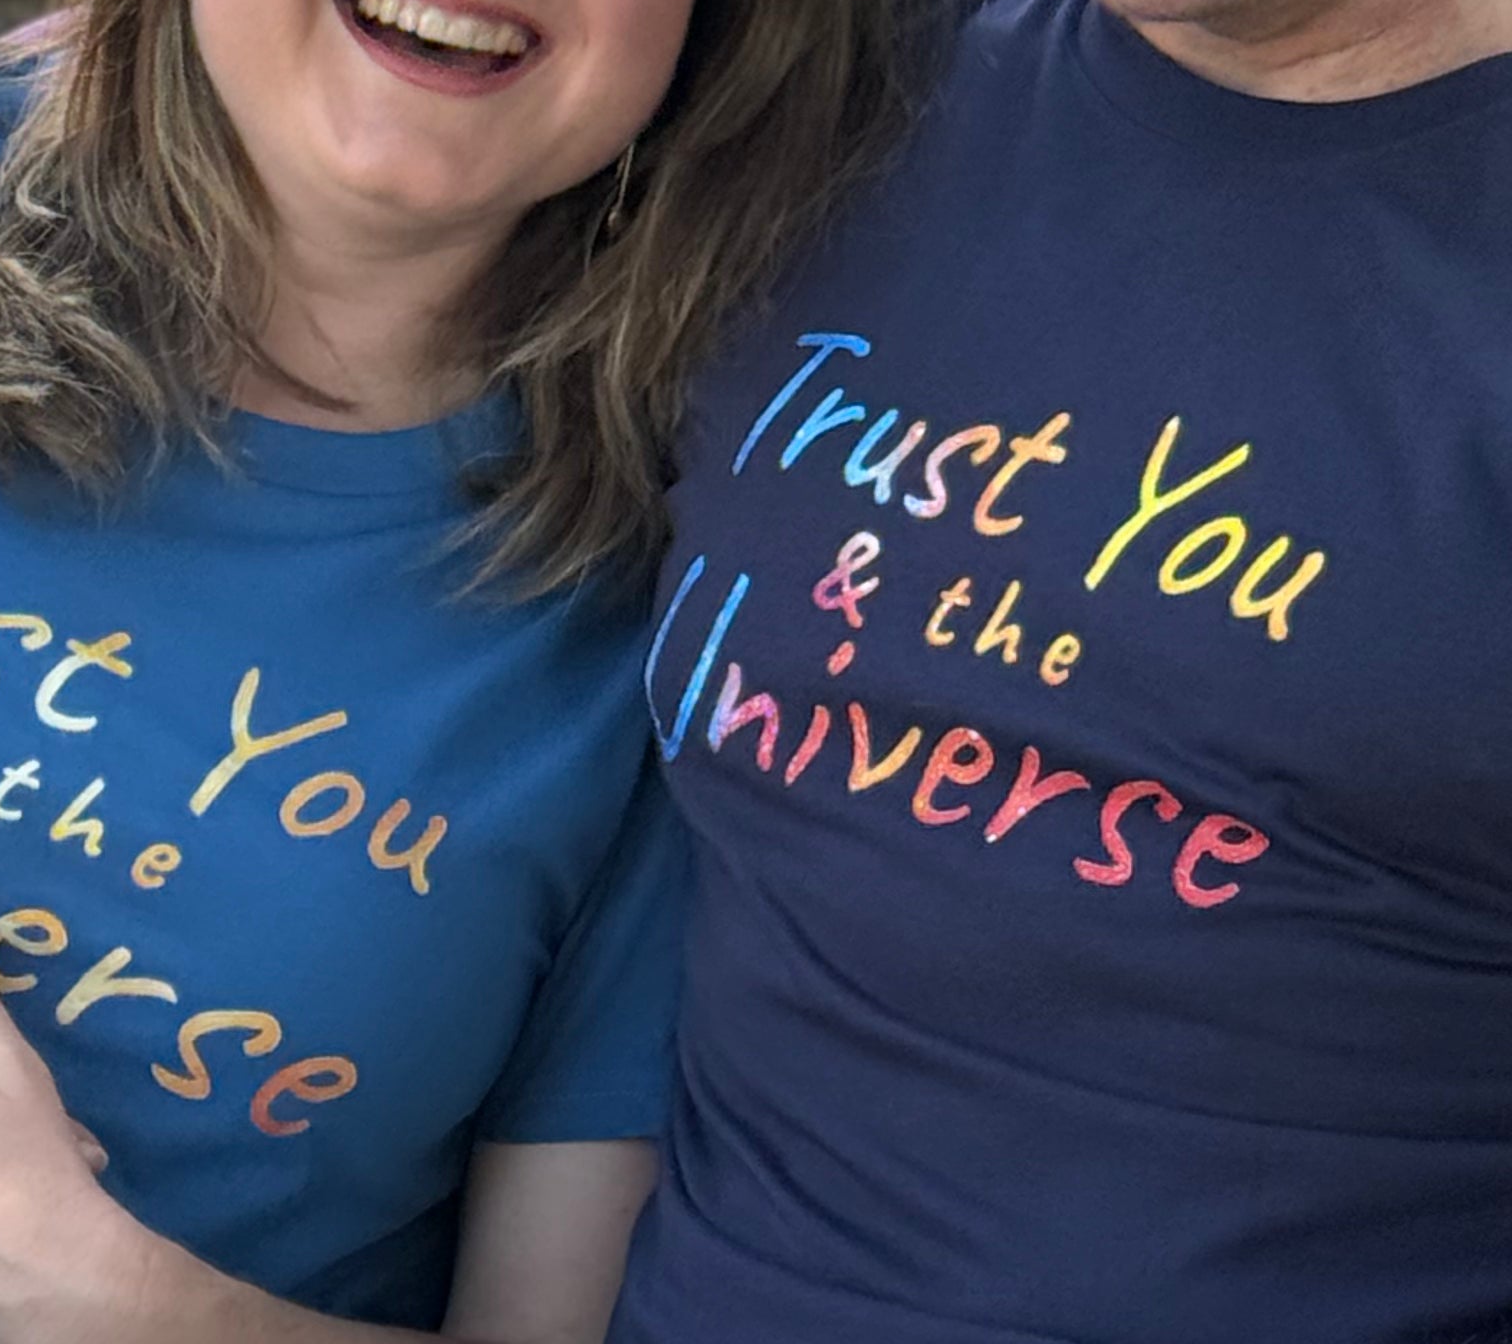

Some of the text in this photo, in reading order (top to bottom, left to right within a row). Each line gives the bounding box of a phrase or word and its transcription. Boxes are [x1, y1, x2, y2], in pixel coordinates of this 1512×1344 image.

[732, 332, 1325, 641] Trust You
[813, 531, 1081, 685] & the
[190, 668, 448, 895] You
[645, 555, 1270, 908] Universe
